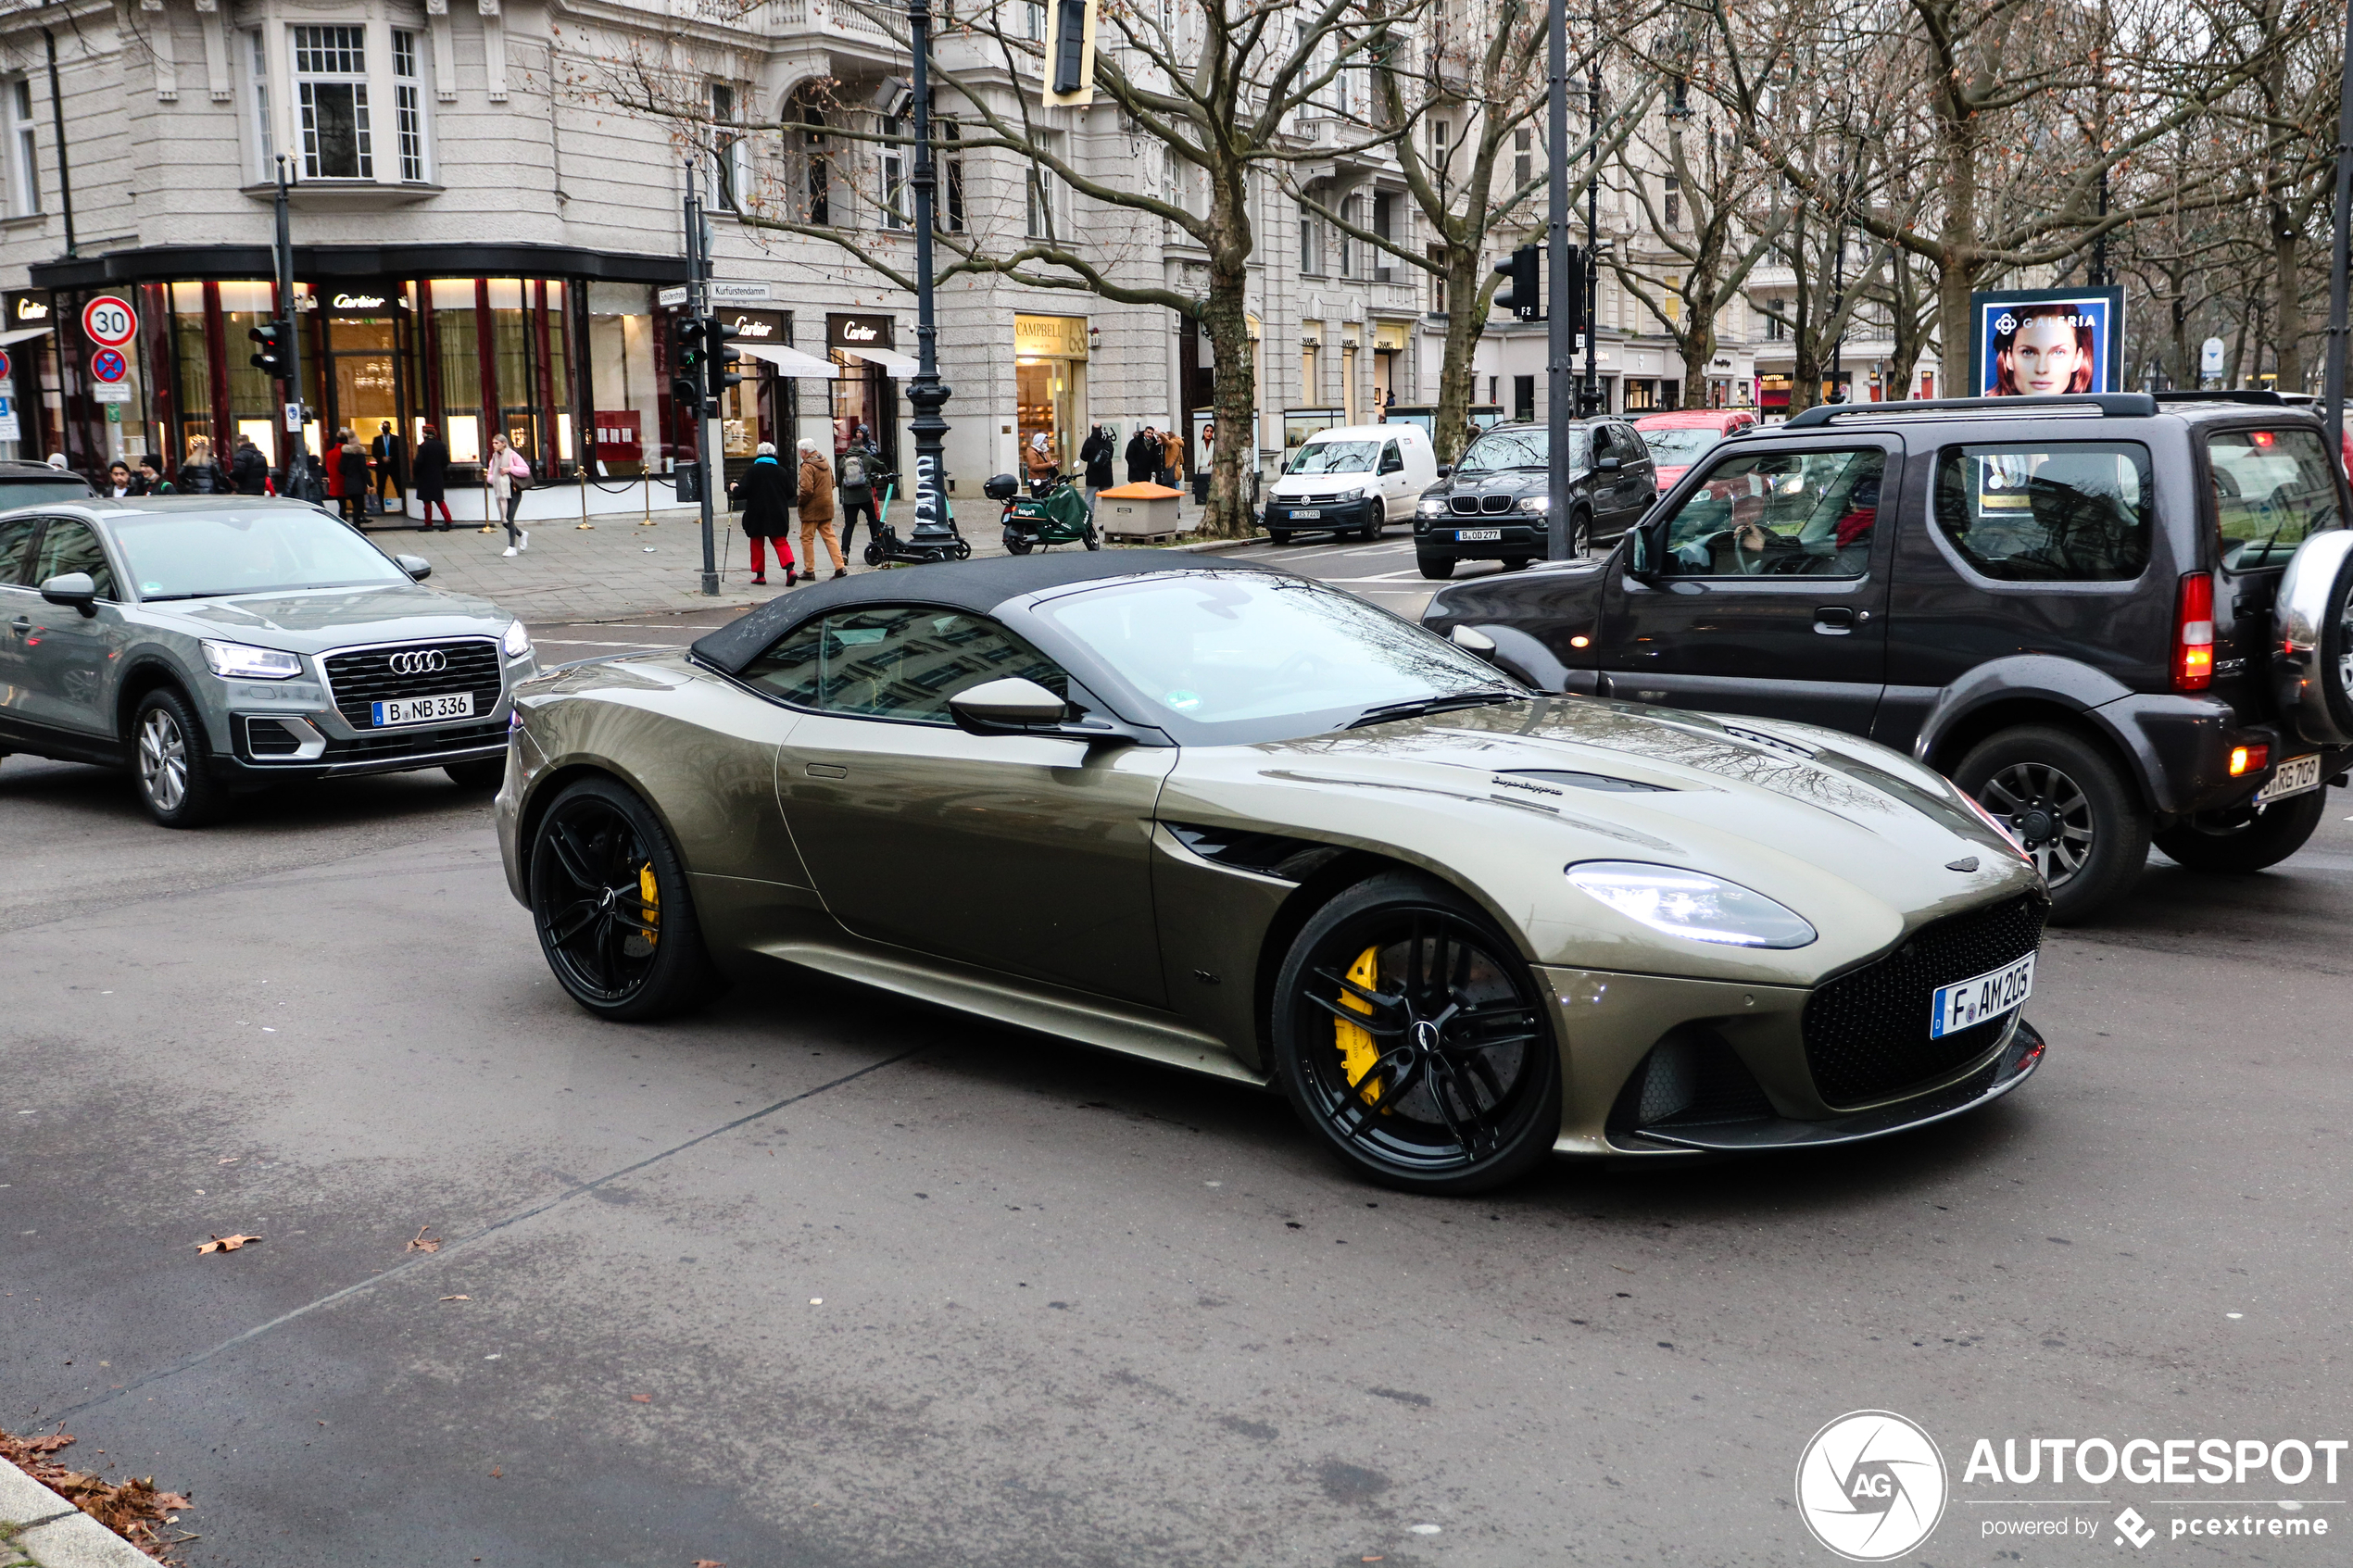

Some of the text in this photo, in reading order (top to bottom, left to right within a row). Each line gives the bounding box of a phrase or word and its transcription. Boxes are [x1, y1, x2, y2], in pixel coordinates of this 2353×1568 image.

[715, 285, 766, 295] Kurfürstendamm
[19, 298, 49, 320] Cartier
[333, 294, 385, 308] Cartier
[95, 311, 125, 333] 30
[735, 315, 773, 337] Cartier
[844, 320, 877, 341] Cartier
[1016, 322, 1063, 337] CAMPBELL
[2022, 314, 2096, 329] GALERIA
[1378, 341, 1394, 349] CHANEL
[1463, 532, 1468, 540] B
[1484, 531, 1498, 539] 277
[390, 703, 401, 721] B
[412, 700, 434, 719] NB
[438, 696, 467, 716] 336
[1953, 988, 1968, 1026] F
[1978, 975, 2003, 1017] AM
[2003, 961, 2030, 1007] 205
